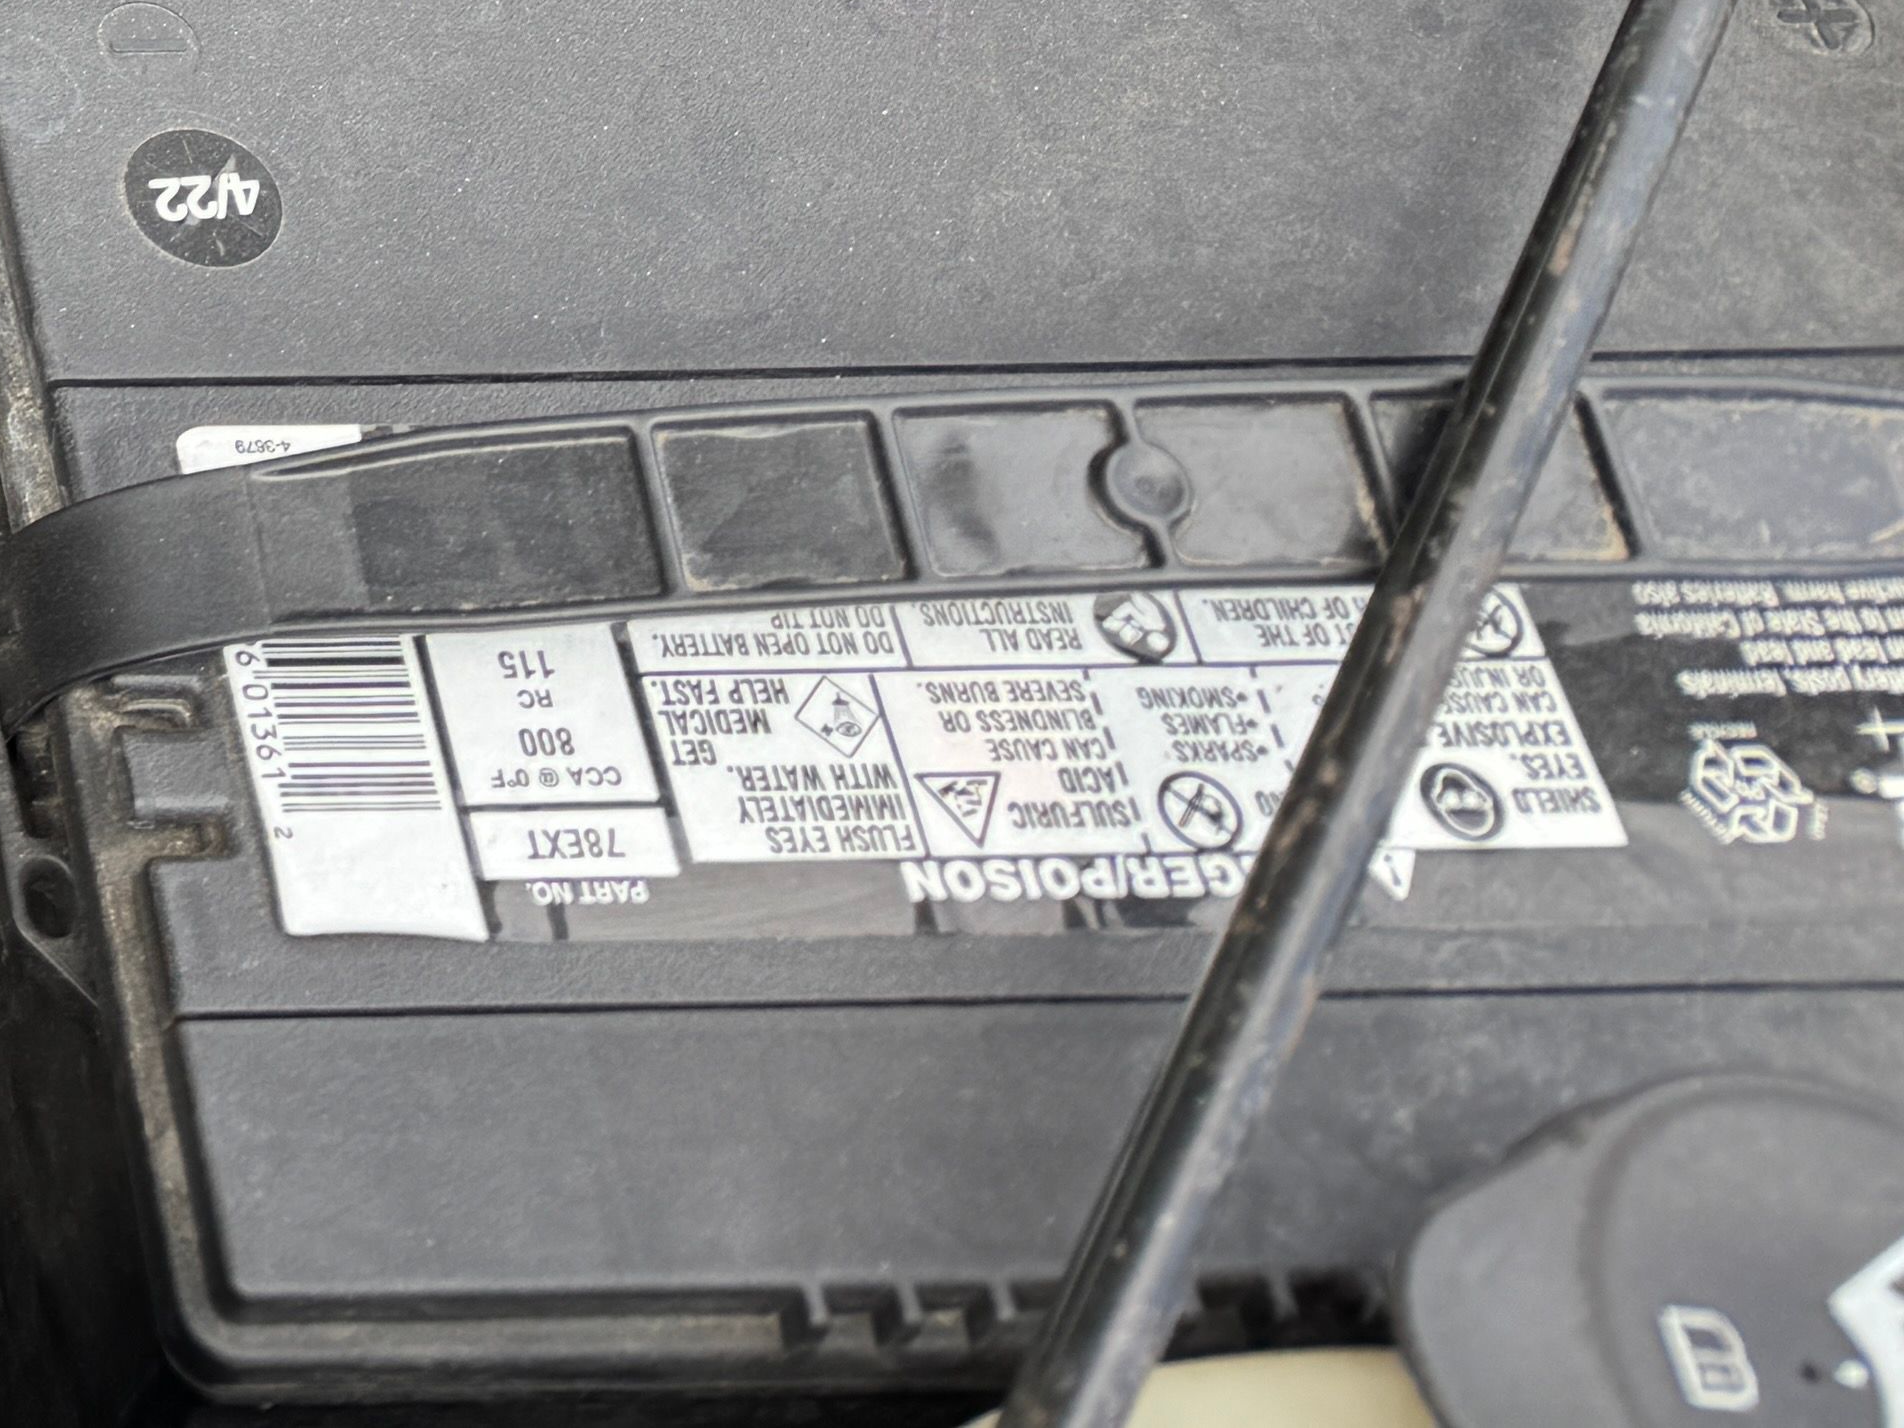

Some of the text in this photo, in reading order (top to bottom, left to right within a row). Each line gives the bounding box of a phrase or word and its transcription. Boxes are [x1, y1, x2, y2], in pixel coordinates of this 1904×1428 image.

[148, 172, 260, 222] 4/22
[771, 605, 884, 630] DO NOT TIP
[911, 601, 1073, 625] INSTRUCTIONS.
[1202, 598, 1317, 622] CHILDREN.
[1319, 598, 1344, 620] OF
[652, 631, 894, 658] DO NOT OPEN BATTERY.
[980, 628, 1082, 653] READ ALL
[1255, 625, 1296, 646] THE
[1301, 624, 1328, 646] OF
[497, 649, 555, 678] 115
[1513, 666, 1546, 687] OR
[516, 688, 552, 709] RC
[650, 678, 789, 705] HELP FAST.
[916, 680, 1084, 703] SEVERE BURNS.
[1135, 687, 1236, 708] SMOKING
[1513, 690, 1557, 713] CAN
[657, 708, 772, 735] MEDICAL
[937, 708, 1093, 733] BLINDNESS OR
[1161, 713, 1246, 734] FLAMES
[518, 727, 575, 757] 800
[1436, 720, 1571, 748] EXPLOSIVE
[672, 739, 717, 766] GET
[986, 737, 1104, 761] CAN CAUSE
[1172, 741, 1257, 762] SPARKS
[538, 768, 560, 788] @
[566, 766, 622, 787] CCA
[726, 763, 898, 790] WITH WATER.
[1509, 753, 1585, 779] EYES.
[1057, 767, 1115, 793] ACID
[737, 793, 905, 824] IMMEDIATELY
[1512, 788, 1603, 814] SHIELD
[1007, 800, 1128, 829] SULFURIC
[527, 827, 626, 860] 78EXT
[765, 824, 916, 854] FLUSH EYES
[901, 852, 1258, 903] GER/POISON
[525, 880, 649, 906] PART NO.
